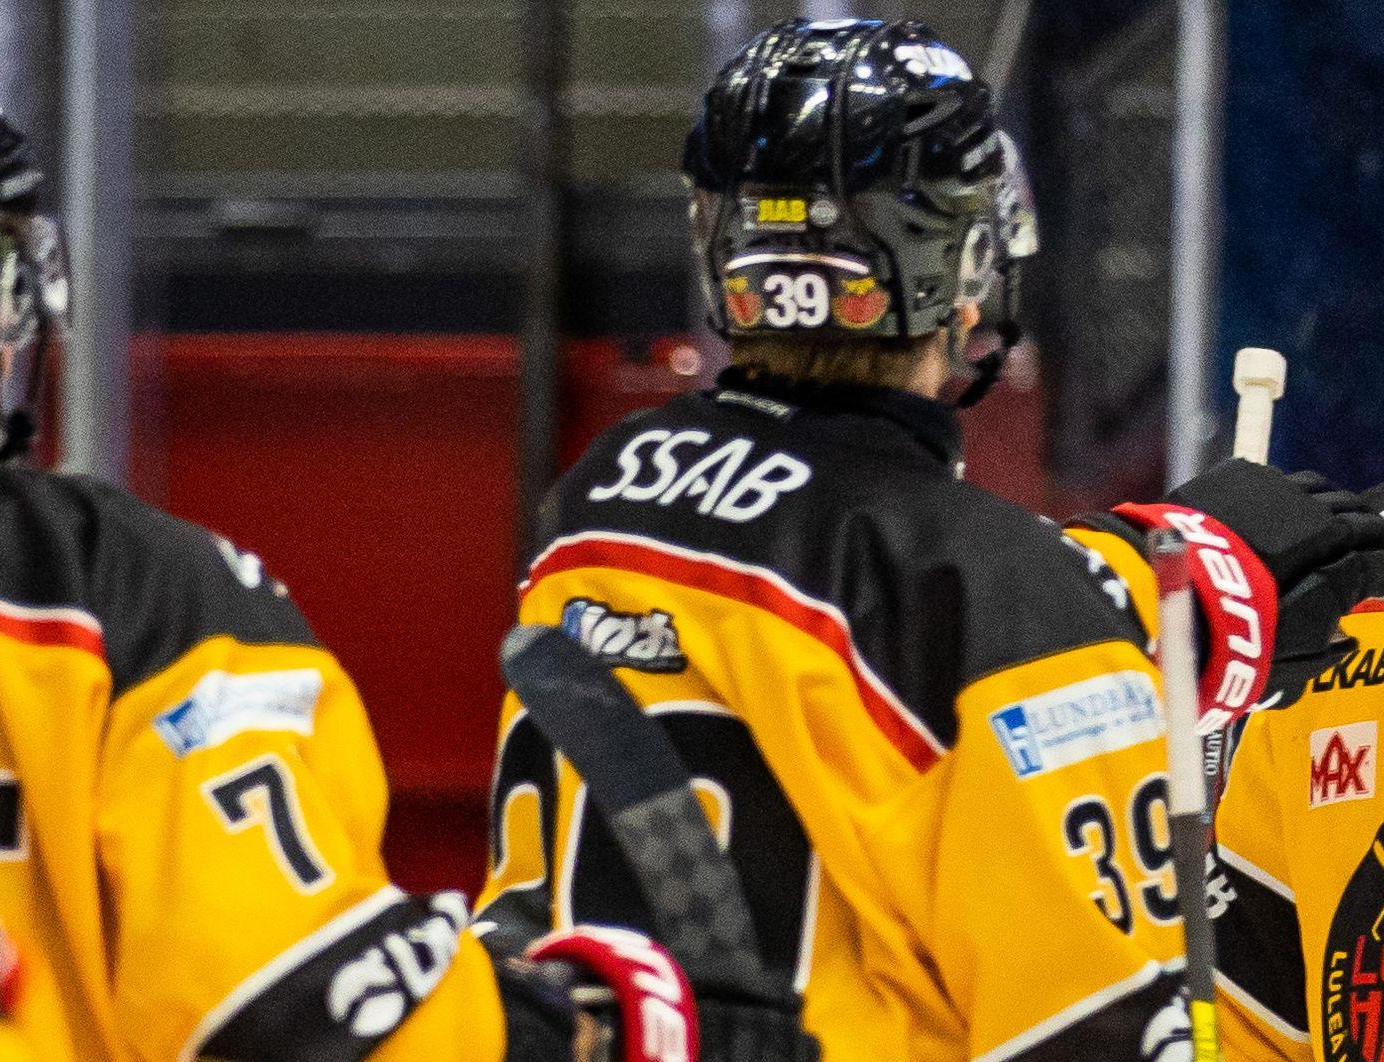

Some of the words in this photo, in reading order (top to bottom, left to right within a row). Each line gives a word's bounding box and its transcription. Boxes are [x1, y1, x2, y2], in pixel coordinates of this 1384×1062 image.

[763, 273, 830, 329] 39
[589, 429, 812, 523] SSAB
[1064, 776, 1183, 936] 39
